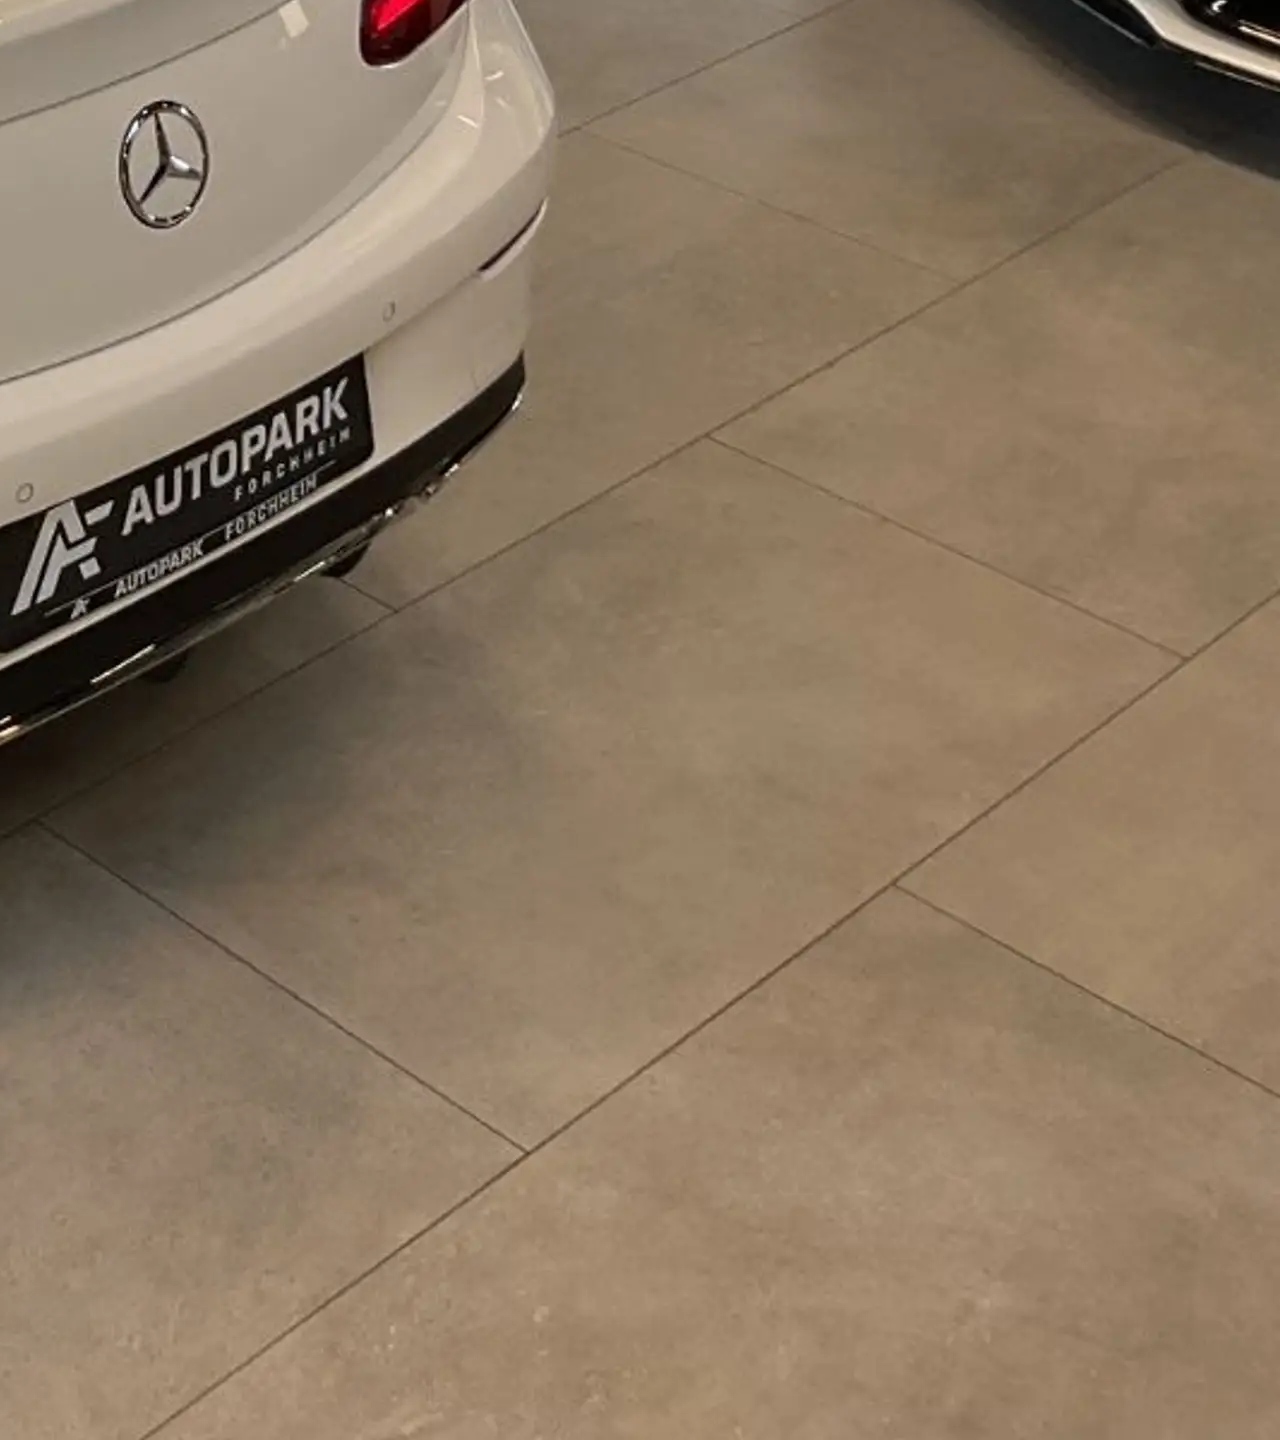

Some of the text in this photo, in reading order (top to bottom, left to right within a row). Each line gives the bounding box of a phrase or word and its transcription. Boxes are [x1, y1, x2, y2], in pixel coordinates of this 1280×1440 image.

[120, 375, 351, 537] AUTOPARK
[235, 429, 351, 501] FORCHHEIM
[113, 474, 318, 600] AUTOPARK FORCHHEIM
